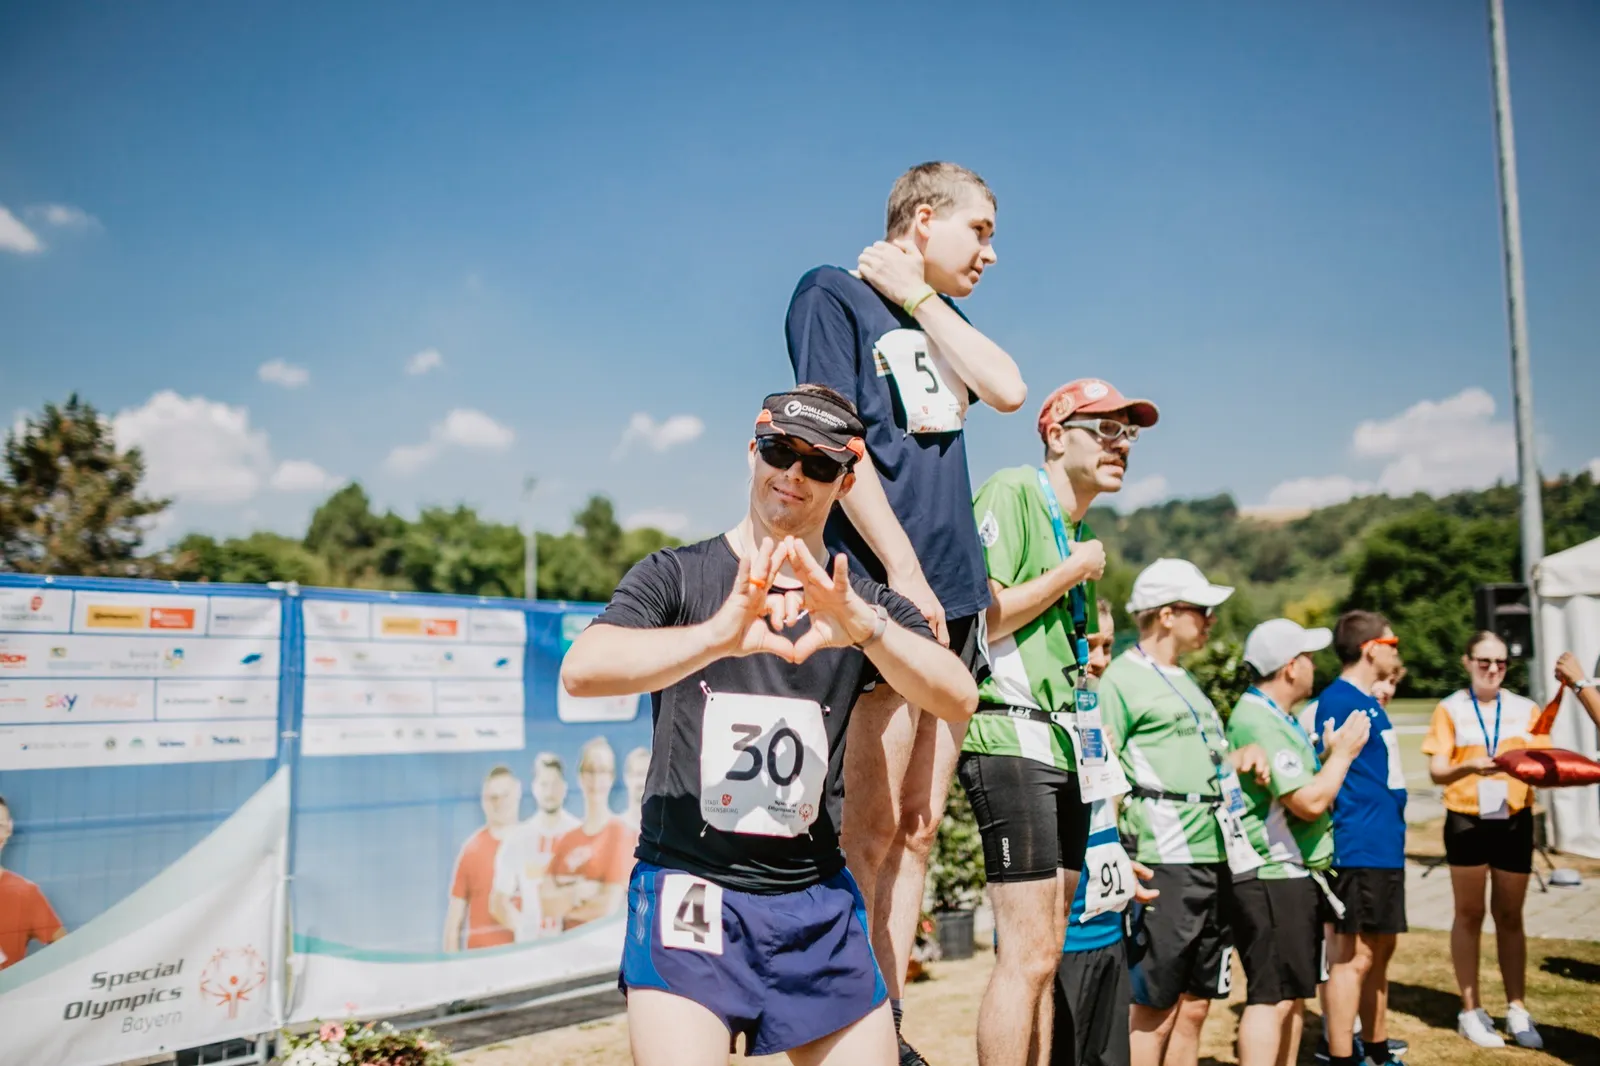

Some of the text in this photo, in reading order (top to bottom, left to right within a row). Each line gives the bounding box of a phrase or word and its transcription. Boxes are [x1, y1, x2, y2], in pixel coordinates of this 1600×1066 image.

[914, 351, 939, 394] 5
[725, 723, 805, 787] 30
[1001, 837, 1010, 862] CRAFT
[1101, 861, 1125, 898] 91
[673, 883, 710, 944] 4
[90, 958, 185, 991] Special
[63, 985, 182, 1021] Olympics
[121, 1010, 183, 1034] Bayern
